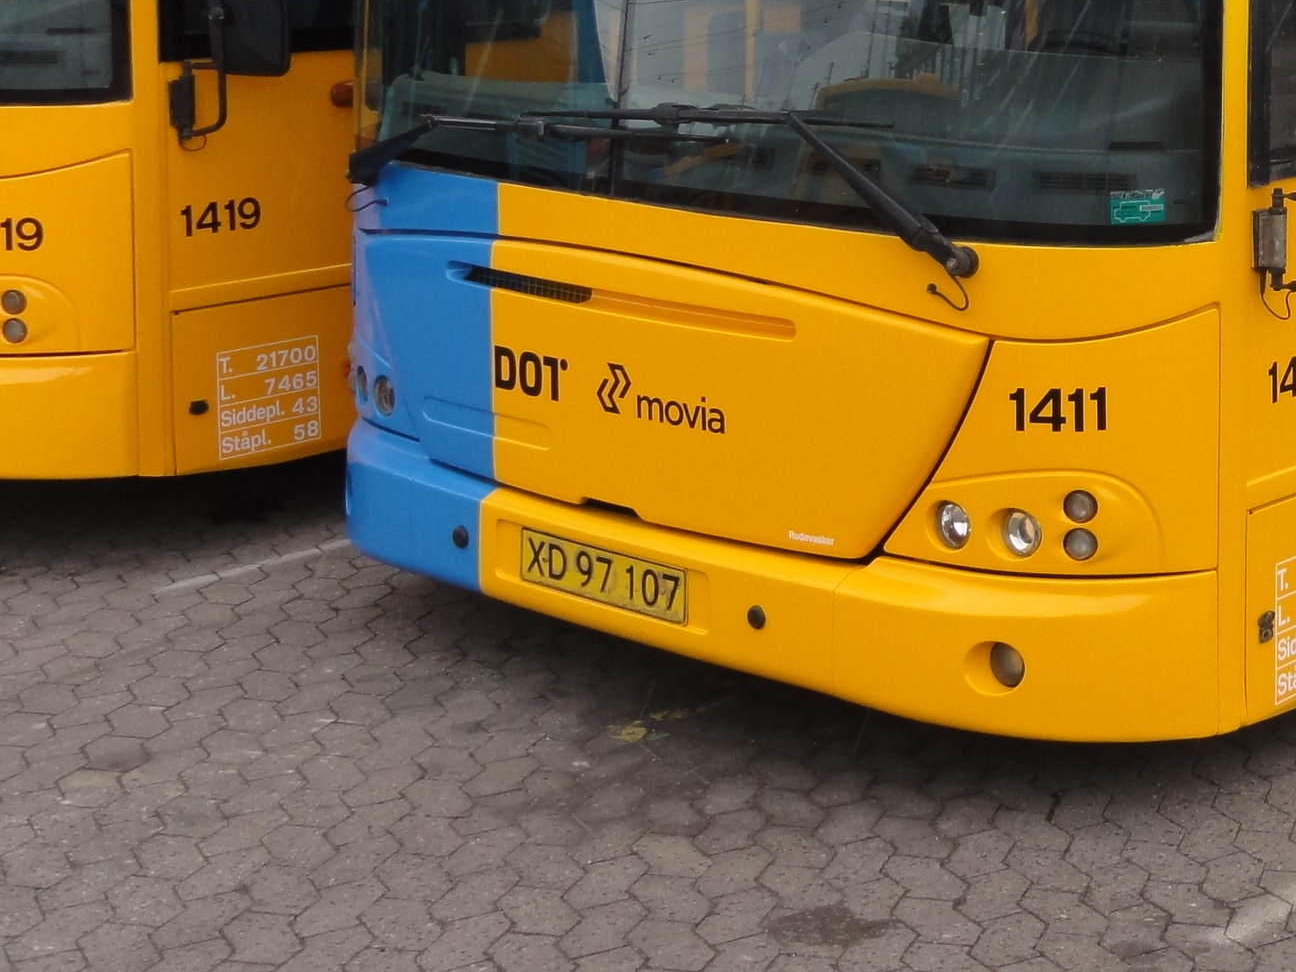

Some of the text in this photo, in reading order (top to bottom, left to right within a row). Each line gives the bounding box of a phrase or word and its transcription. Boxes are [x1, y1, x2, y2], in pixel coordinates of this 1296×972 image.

[180, 197, 261, 237] 1419
[0, 217, 44, 251] 19
[219, 345, 316, 374] T. 21700
[494, 345, 566, 402] DOT
[220, 371, 317, 401] L. 7465
[221, 396, 318, 427] Siddepl. 43
[636, 394, 725, 434] movia
[1009, 387, 1106, 432] 1411
[222, 420, 319, 453] Ståpl. 58
[527, 538, 680, 610] XD 97 107
[1277, 568, 1289, 591] T.
[1278, 605, 1290, 627] L.
